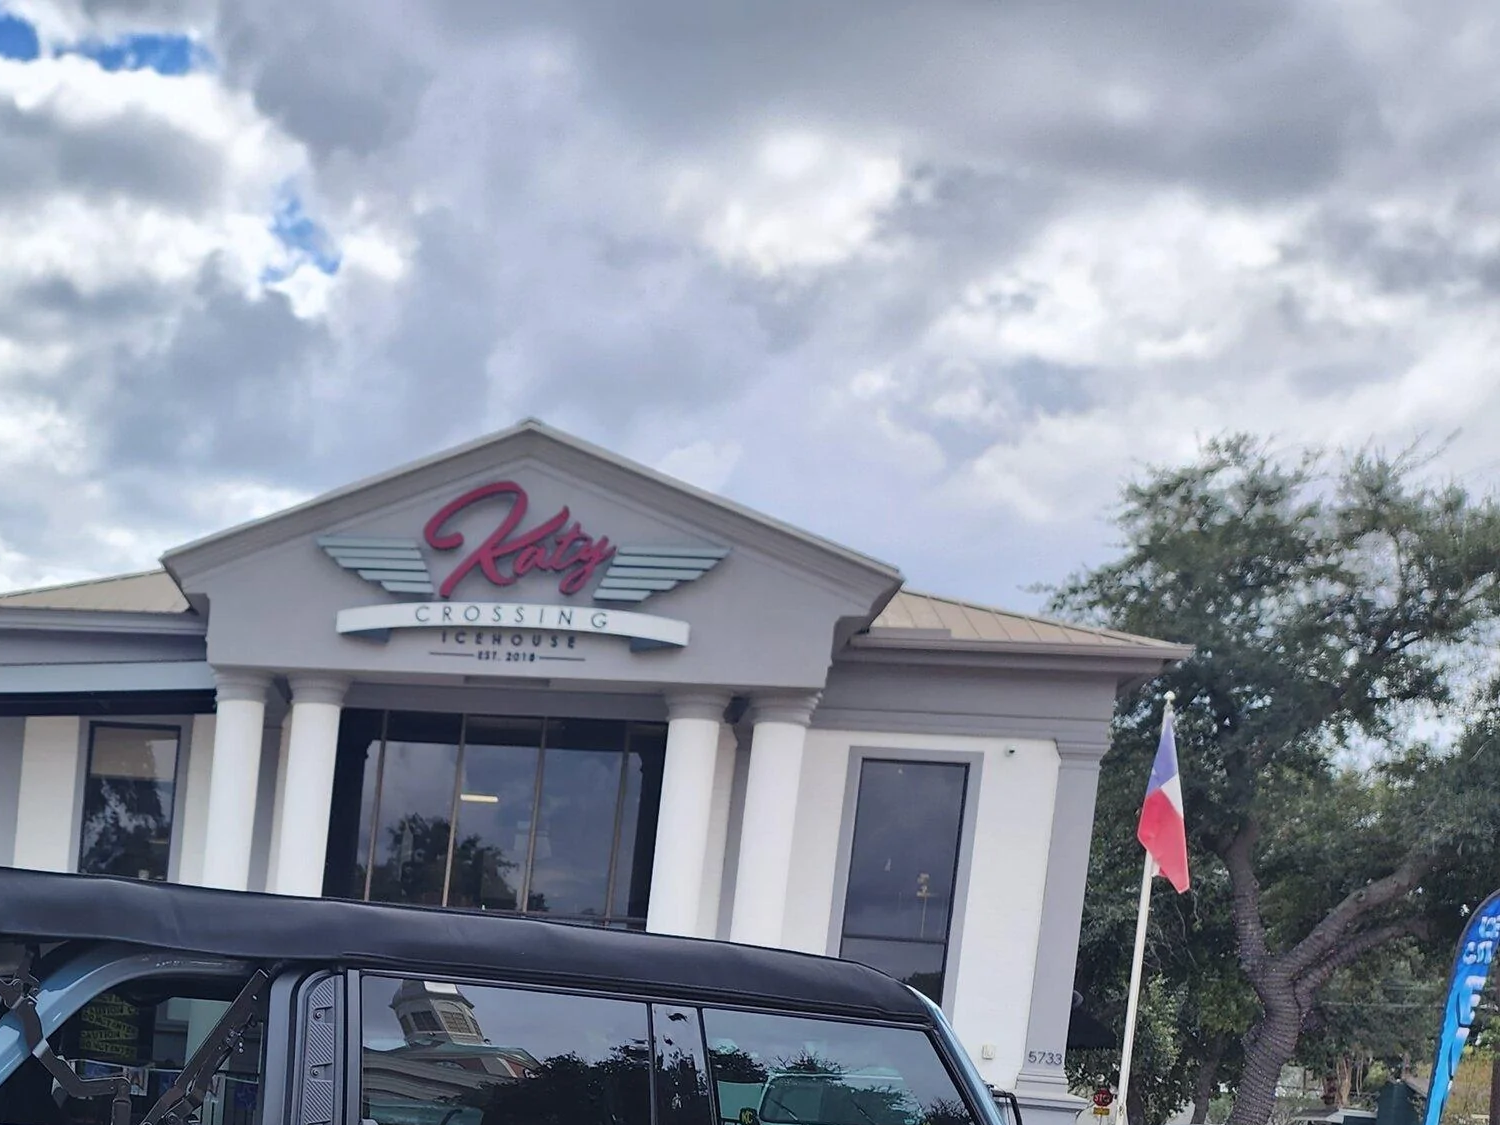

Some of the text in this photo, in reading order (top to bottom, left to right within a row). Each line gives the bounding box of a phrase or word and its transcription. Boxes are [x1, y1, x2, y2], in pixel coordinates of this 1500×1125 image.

[423, 480, 617, 598] Katy
[414, 605, 608, 629] CROSSING
[441, 630, 576, 649] ICEHOUSE
[1028, 1051, 1063, 1065] 5733
